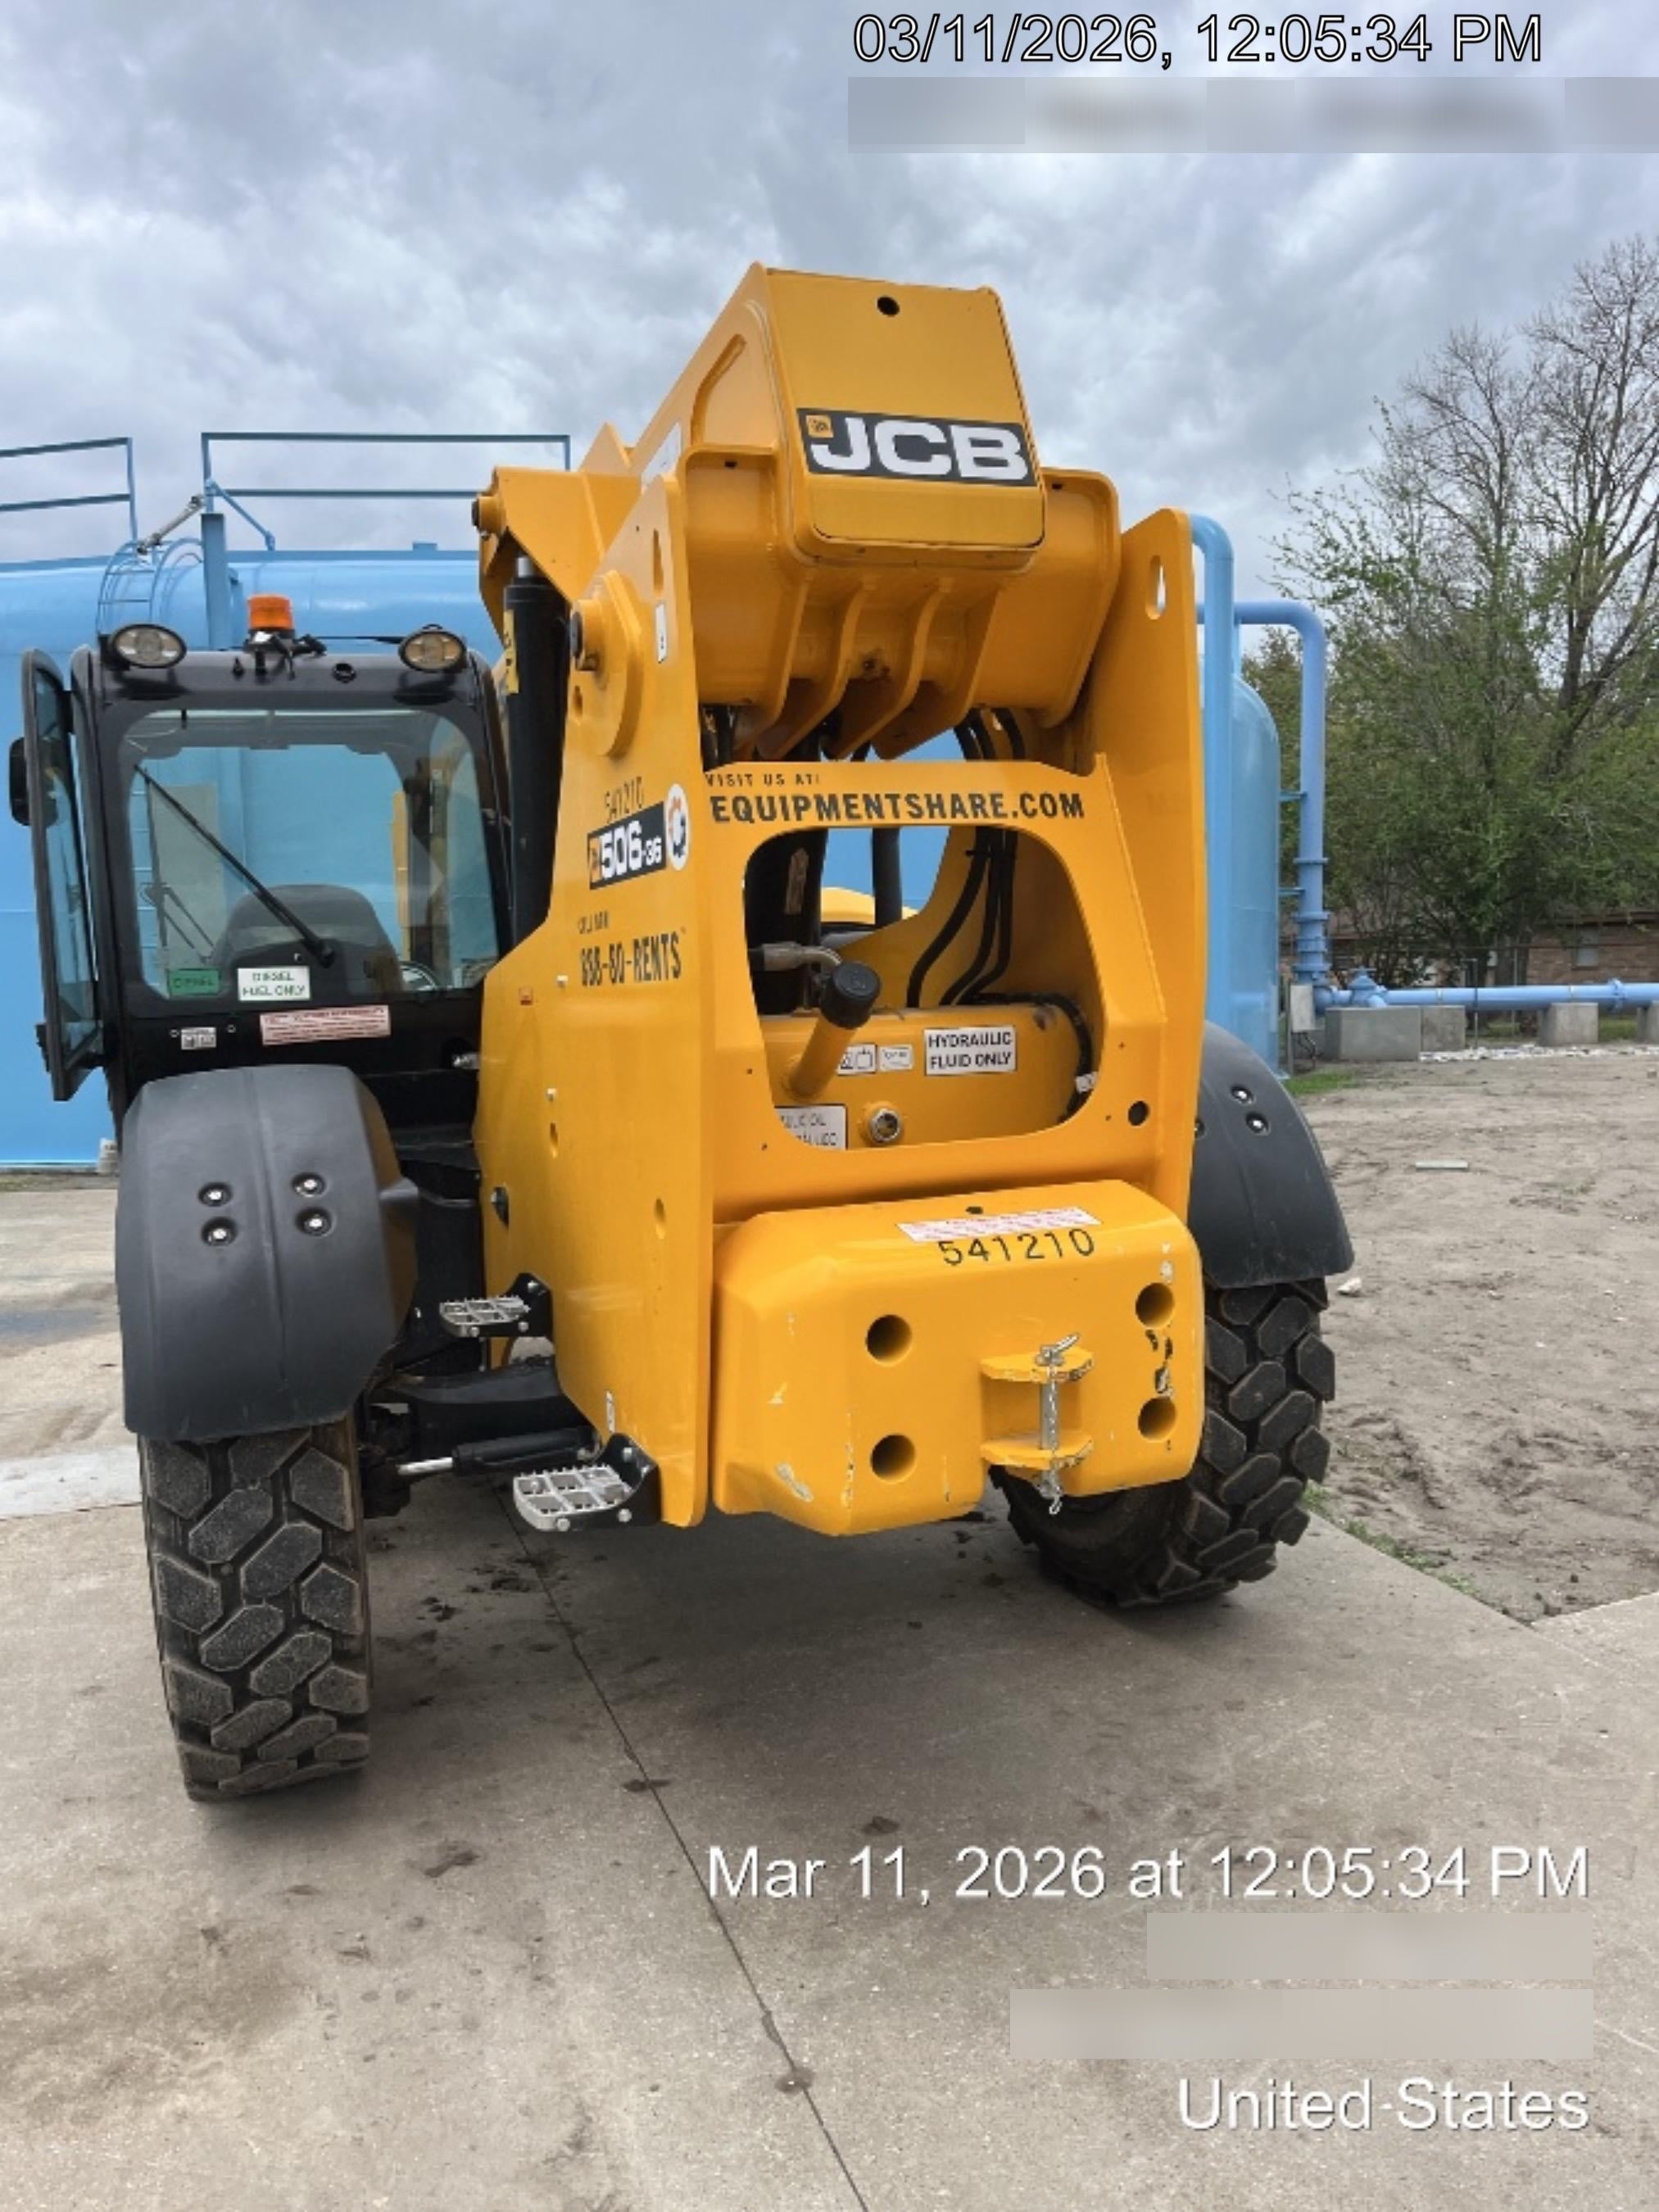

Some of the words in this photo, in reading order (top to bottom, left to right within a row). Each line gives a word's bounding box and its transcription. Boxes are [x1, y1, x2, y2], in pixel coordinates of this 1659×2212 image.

[810, 417, 1028, 480] JCB
[705, 773, 753, 786] VISIT
[764, 773, 785, 786] US
[709, 792, 1085, 823] EQUIPMENTSHARE.COM
[601, 820, 662, 879] 506-36
[928, 1031, 1013, 1048] HYDRAULIC
[931, 1054, 972, 1069] FLUID
[976, 1051, 1011, 1067] ONLY
[938, 1228, 1095, 1266] 541210
